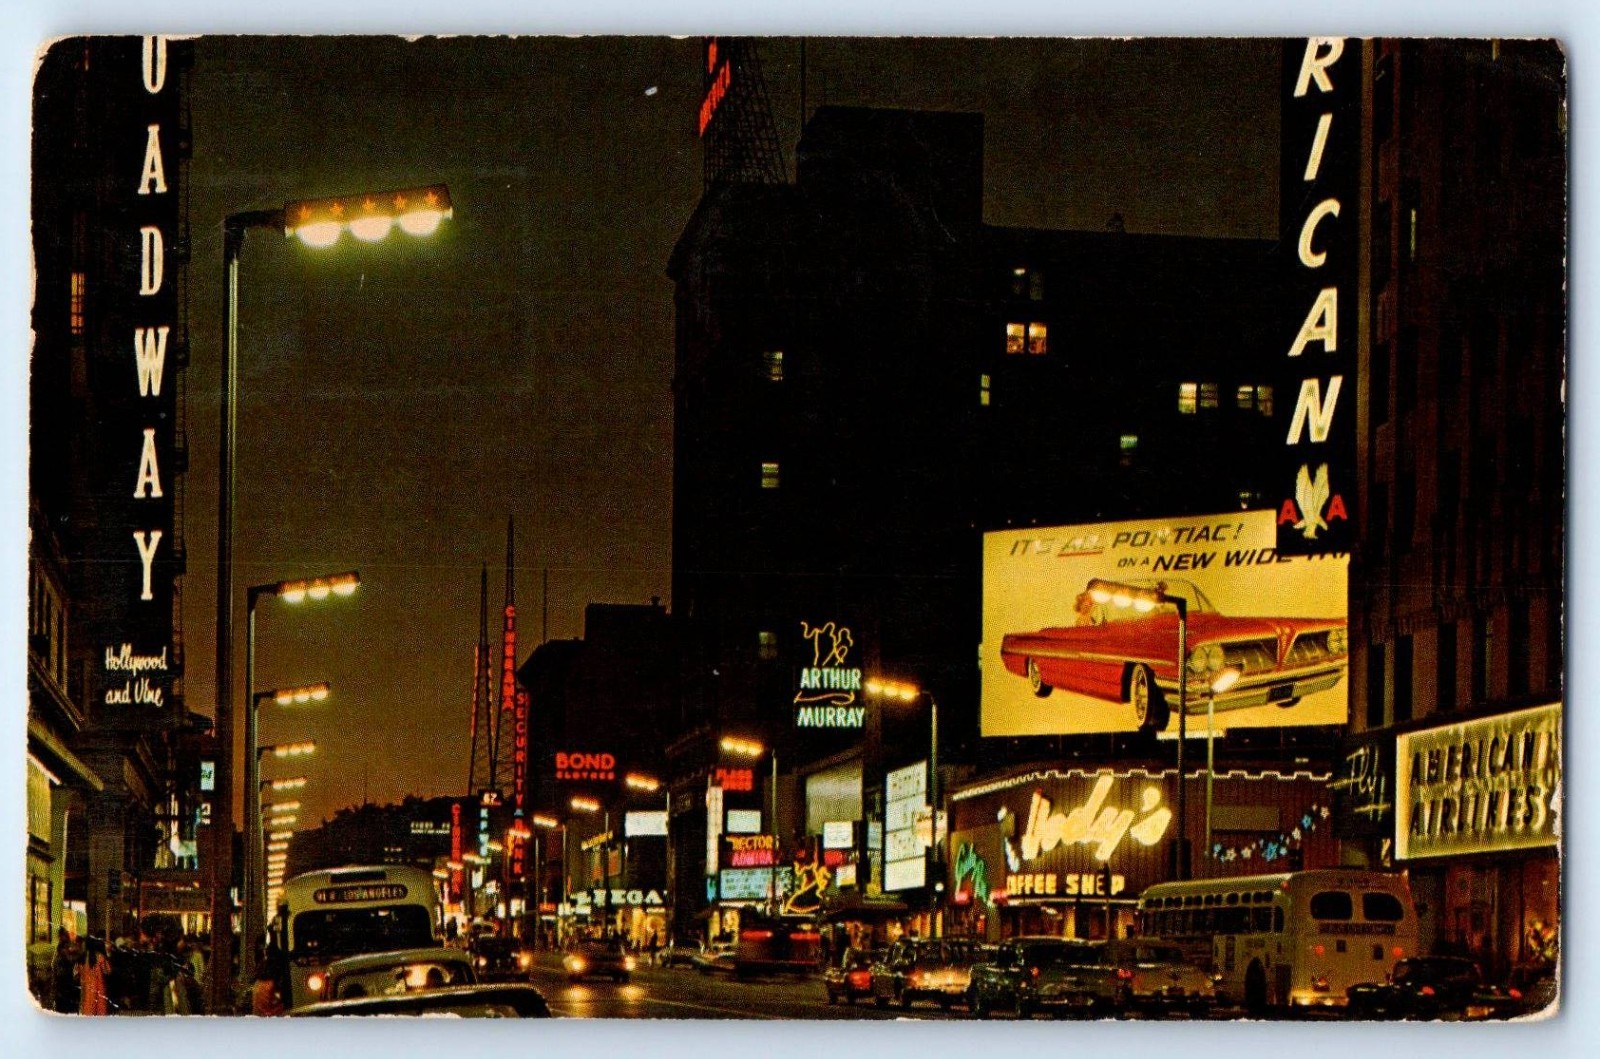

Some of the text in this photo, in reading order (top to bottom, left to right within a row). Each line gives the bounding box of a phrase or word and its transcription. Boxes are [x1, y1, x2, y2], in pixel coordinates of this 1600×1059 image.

[1117, 556, 1138, 568] ON
[1140, 557, 1150, 566] A
[1151, 552, 1217, 572] NEW
[105, 643, 168, 676] Hollywood
[105, 677, 164, 707] and Vine
[800, 667, 862, 689] ARTHUR
[797, 706, 865, 728] MURRAY
[515, 691, 526, 805] SECURITY
[555, 752, 615, 770] BOND
[1410, 730, 1538, 787] AMERICAN
[1410, 785, 1541, 838] AIRLINES
